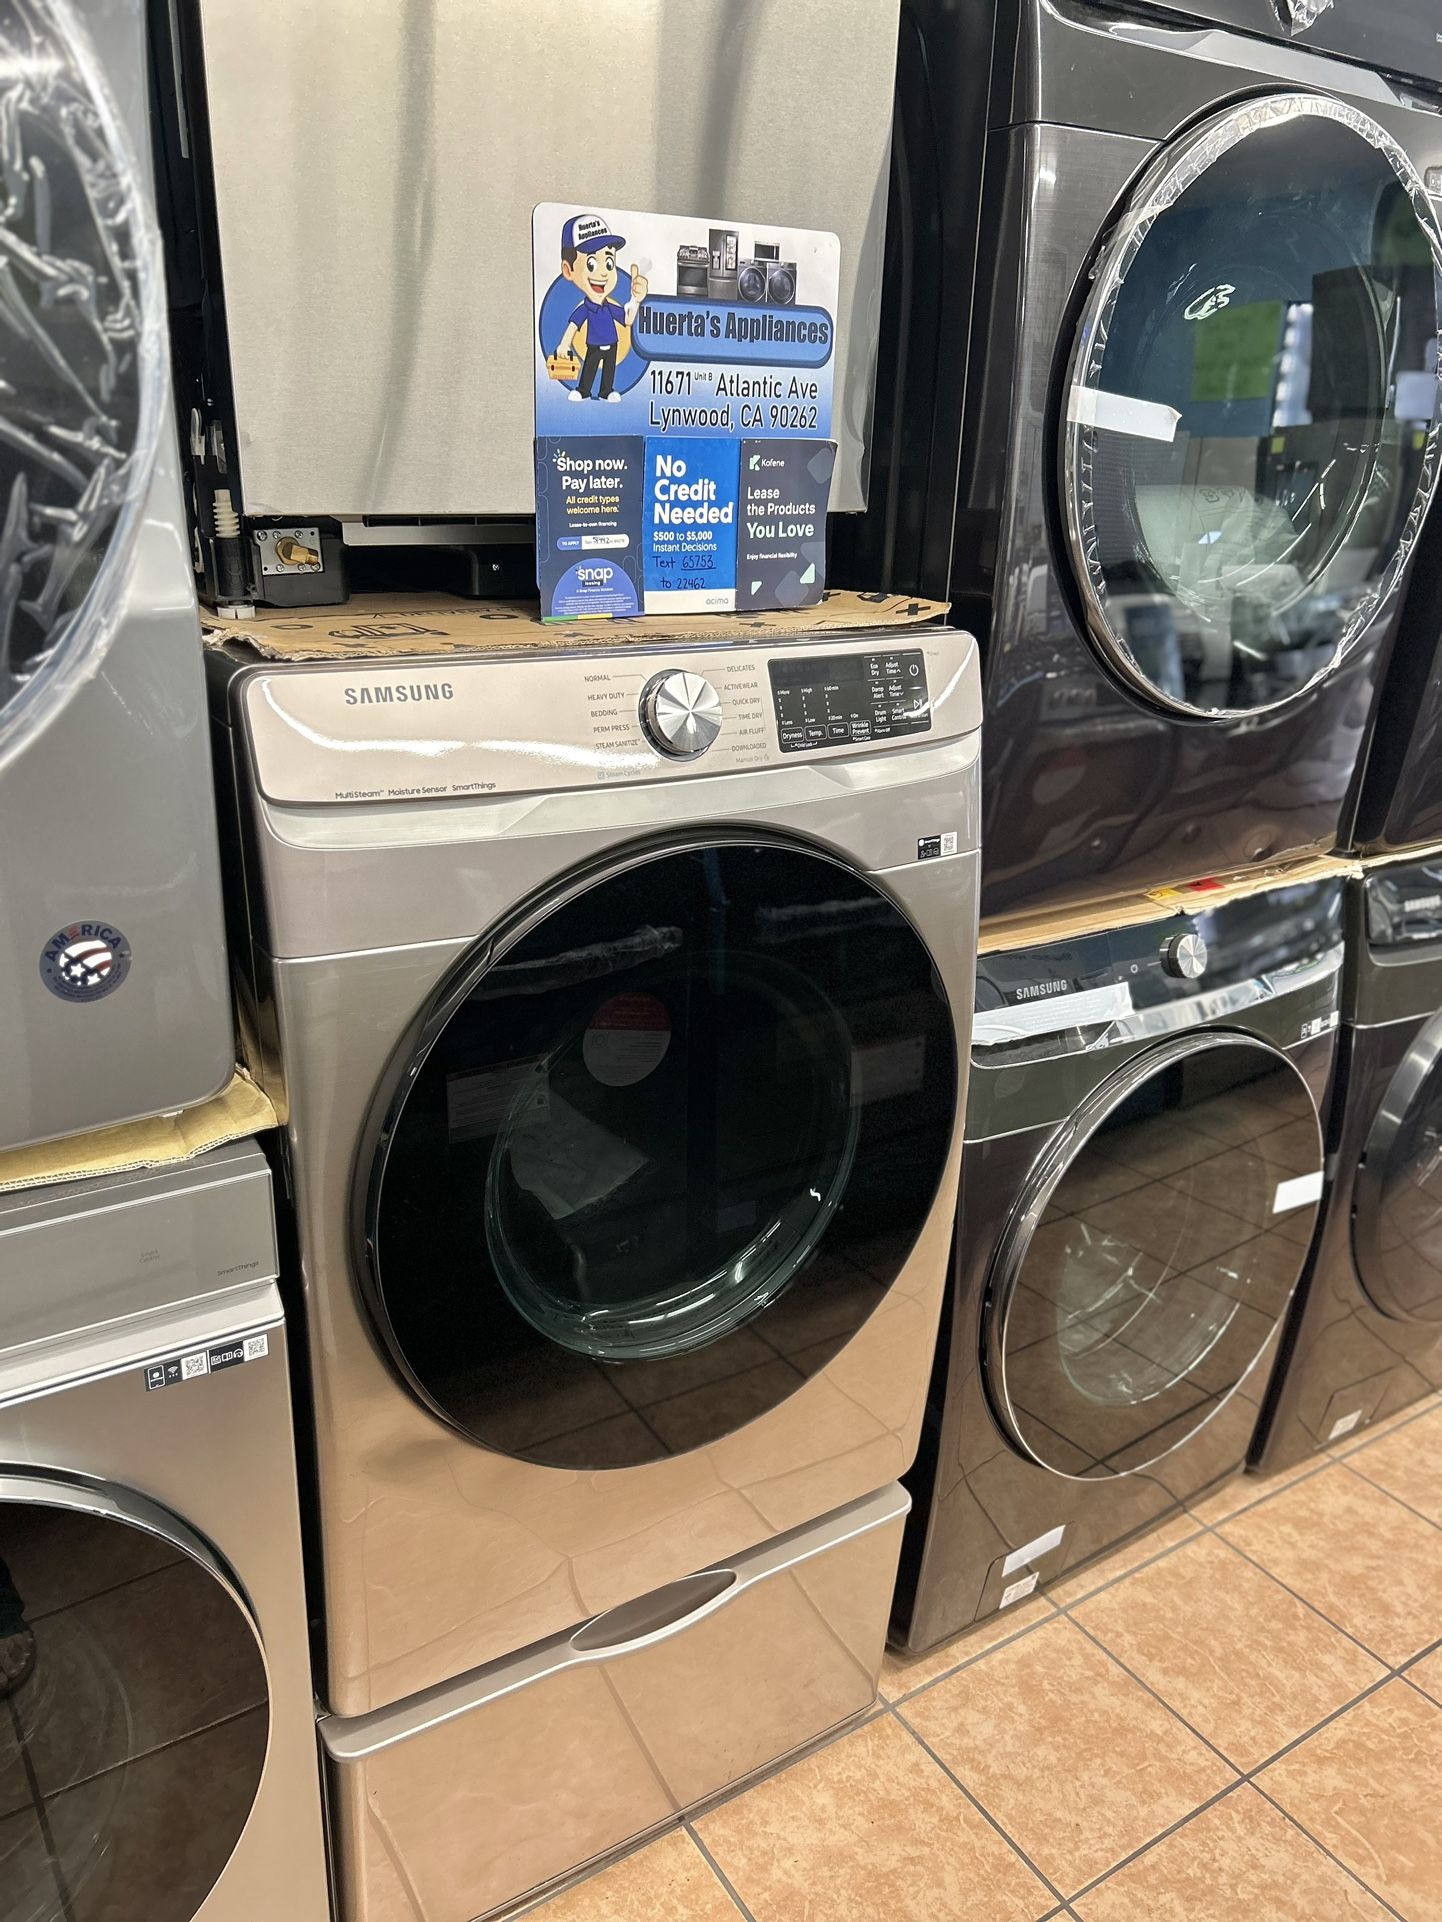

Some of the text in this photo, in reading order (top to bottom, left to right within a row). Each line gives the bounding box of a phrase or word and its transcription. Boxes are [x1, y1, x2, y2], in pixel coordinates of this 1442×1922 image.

[578, 220, 600, 231] Huerta's
[578, 227, 607, 240] Appliances
[638, 306, 829, 344] Huerta's Appliances
[650, 370, 692, 395] 11671
[694, 372, 707, 381] Unit
[716, 373, 782, 398] Atlantic
[787, 376, 818, 399] Ave
[650, 401, 817, 431] Lynwood, CA 90262
[557, 457, 628, 474] Shop now.
[655, 455, 687, 477] No
[562, 475, 624, 493] Pay later.
[654, 479, 716, 501] Credit
[747, 487, 780, 500] Lease
[566, 495, 620, 505] All credit types
[566, 505, 600, 514] welcome
[653, 502, 734, 525] Needed
[746, 502, 816, 516] the Products
[653, 531, 713, 541] $500 to $5,000
[746, 522, 815, 539] You Love
[653, 542, 718, 552] Instant Decisions
[652, 554, 714, 569] Text 65753
[578, 567, 614, 584] snap
[660, 577, 706, 589] to 22462
[705, 597, 729, 606] acima
[726, 664, 756, 673] DELICATES
[584, 674, 611, 683] NORMAL
[723, 682, 758, 690] ACTIVEWEAR
[344, 683, 454, 705] SAMSUNG
[587, 692, 625, 701] HEAVY DUTY
[732, 697, 761, 706] QUICK DRY
[591, 708, 618, 718] BEDDING
[738, 711, 763, 721] TIME DRY
[593, 724, 630, 734] PERM PRESS
[748, 727, 764, 735] FLUFF
[782, 732, 803, 740] Dryness
[596, 742, 615, 750] STEAM
[731, 743, 767, 752] DOWNLOADED
[388, 786, 421, 797] Moisture
[421, 785, 448, 794] Sensor
[451, 781, 497, 792] SmartThings
[45, 924, 121, 962] AMERICA
[1016, 980, 1068, 1000] SAMSUNG
[217, 1261, 259, 1276] SmartThings
